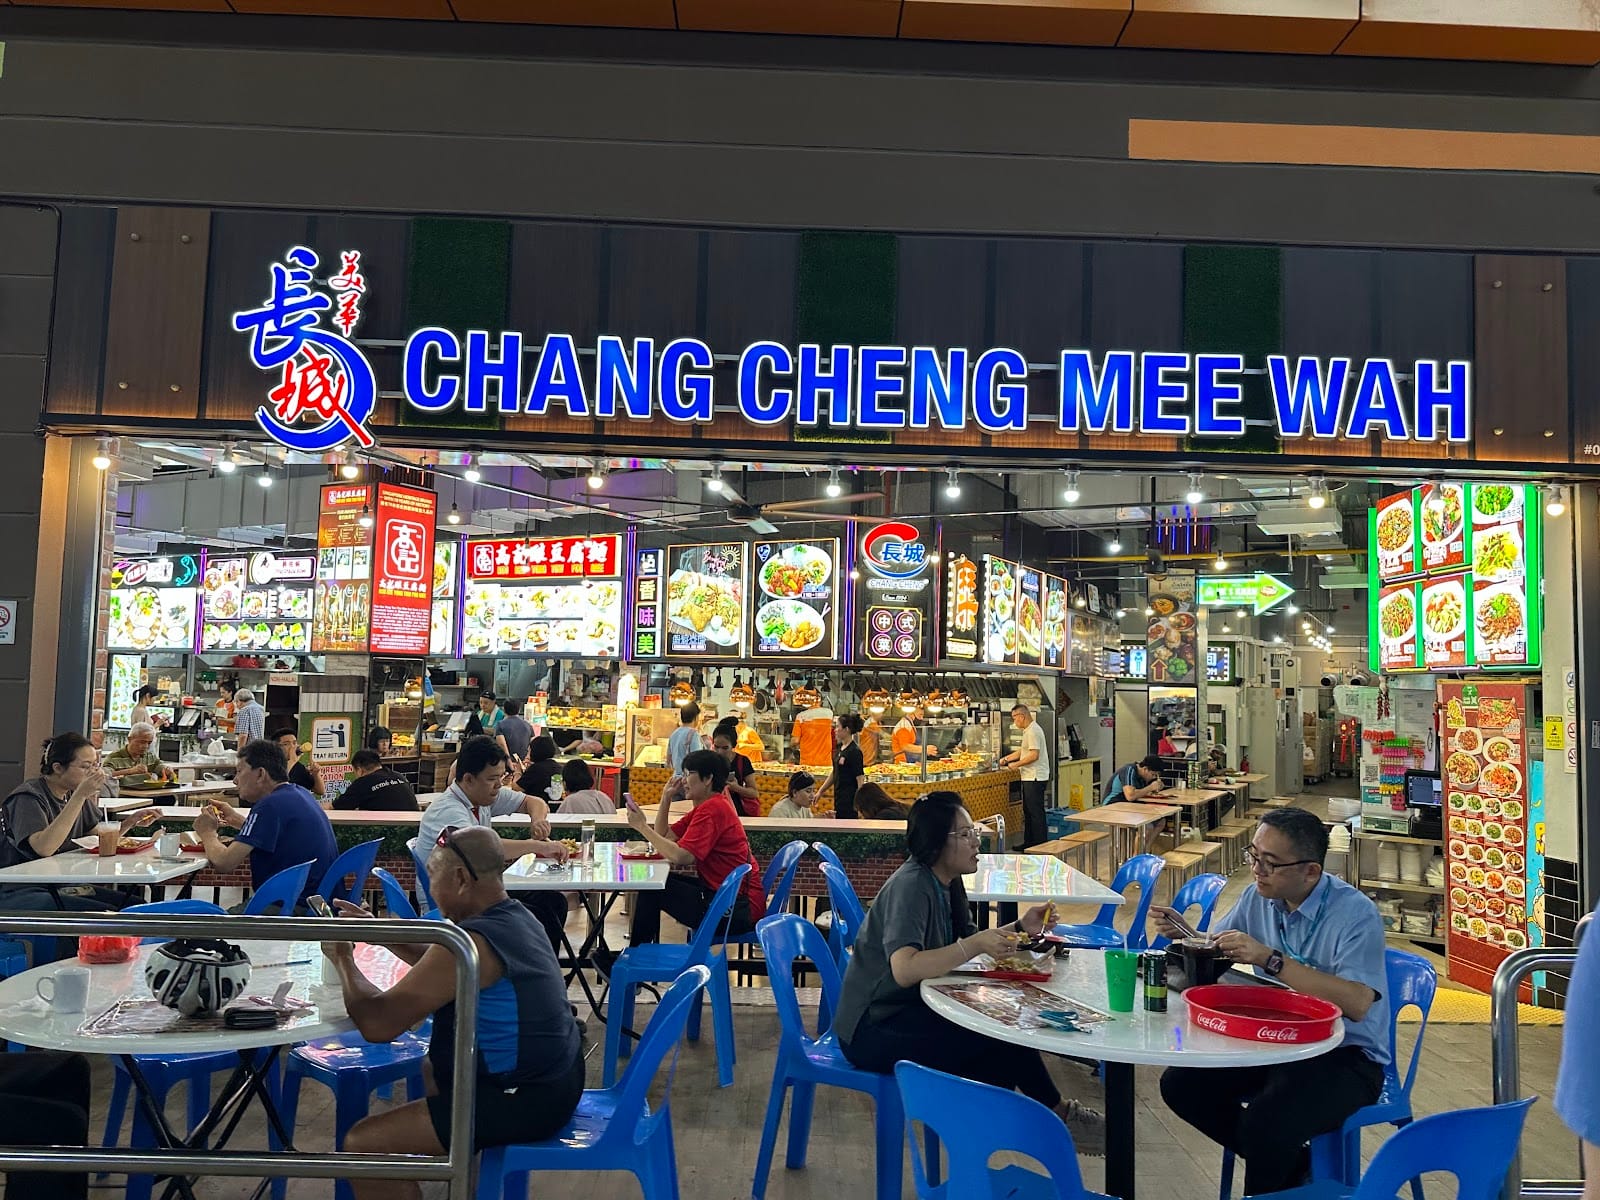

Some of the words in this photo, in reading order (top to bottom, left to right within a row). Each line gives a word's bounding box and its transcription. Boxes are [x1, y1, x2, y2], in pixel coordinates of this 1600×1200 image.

[403, 327, 714, 422] CHANG
[737, 341, 1028, 430] CHENG
[1060, 350, 1245, 435] MEE
[1268, 355, 1469, 442] WAH
[881, 543, 925, 563] 長城
